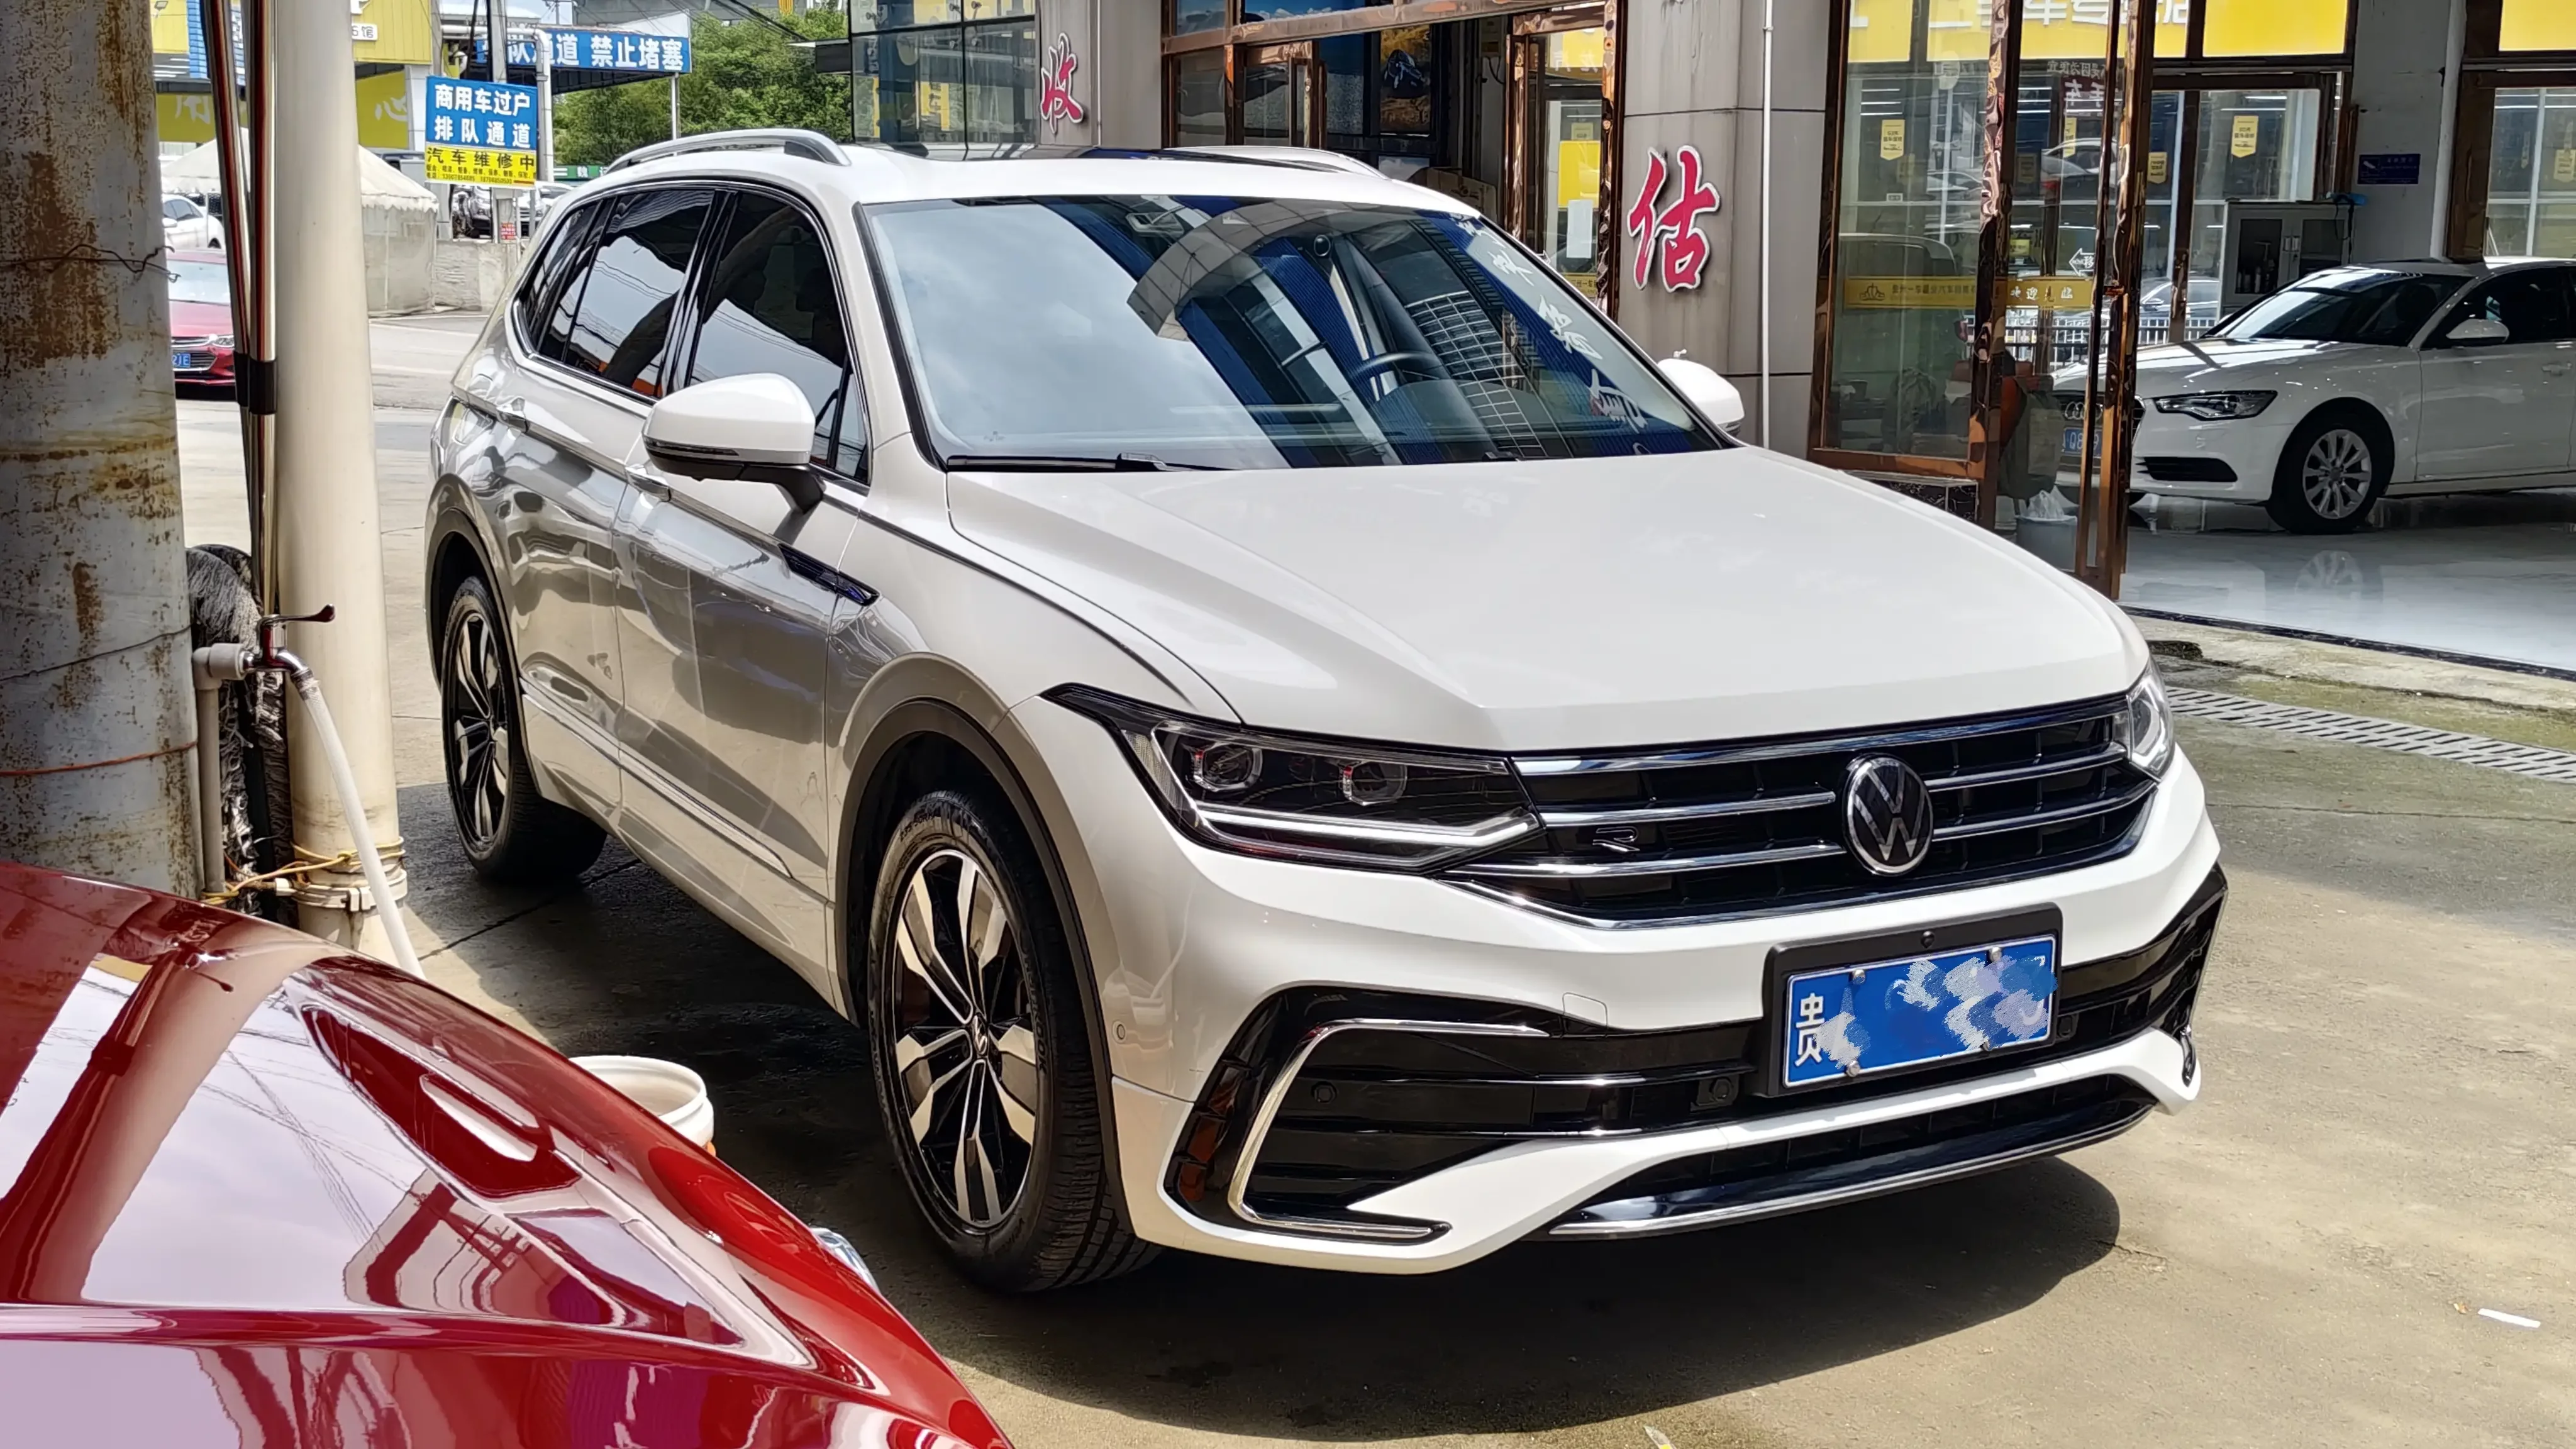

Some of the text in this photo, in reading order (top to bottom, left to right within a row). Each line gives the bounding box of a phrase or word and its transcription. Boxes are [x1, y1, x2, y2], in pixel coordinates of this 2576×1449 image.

[591, 35, 684, 71] 禁止堵塞
[434, 84, 531, 117] 商用车过户
[433, 114, 531, 148] 排队通道
[426, 147, 534, 170] 汽车维修中
[1627, 145, 1721, 293] 估
